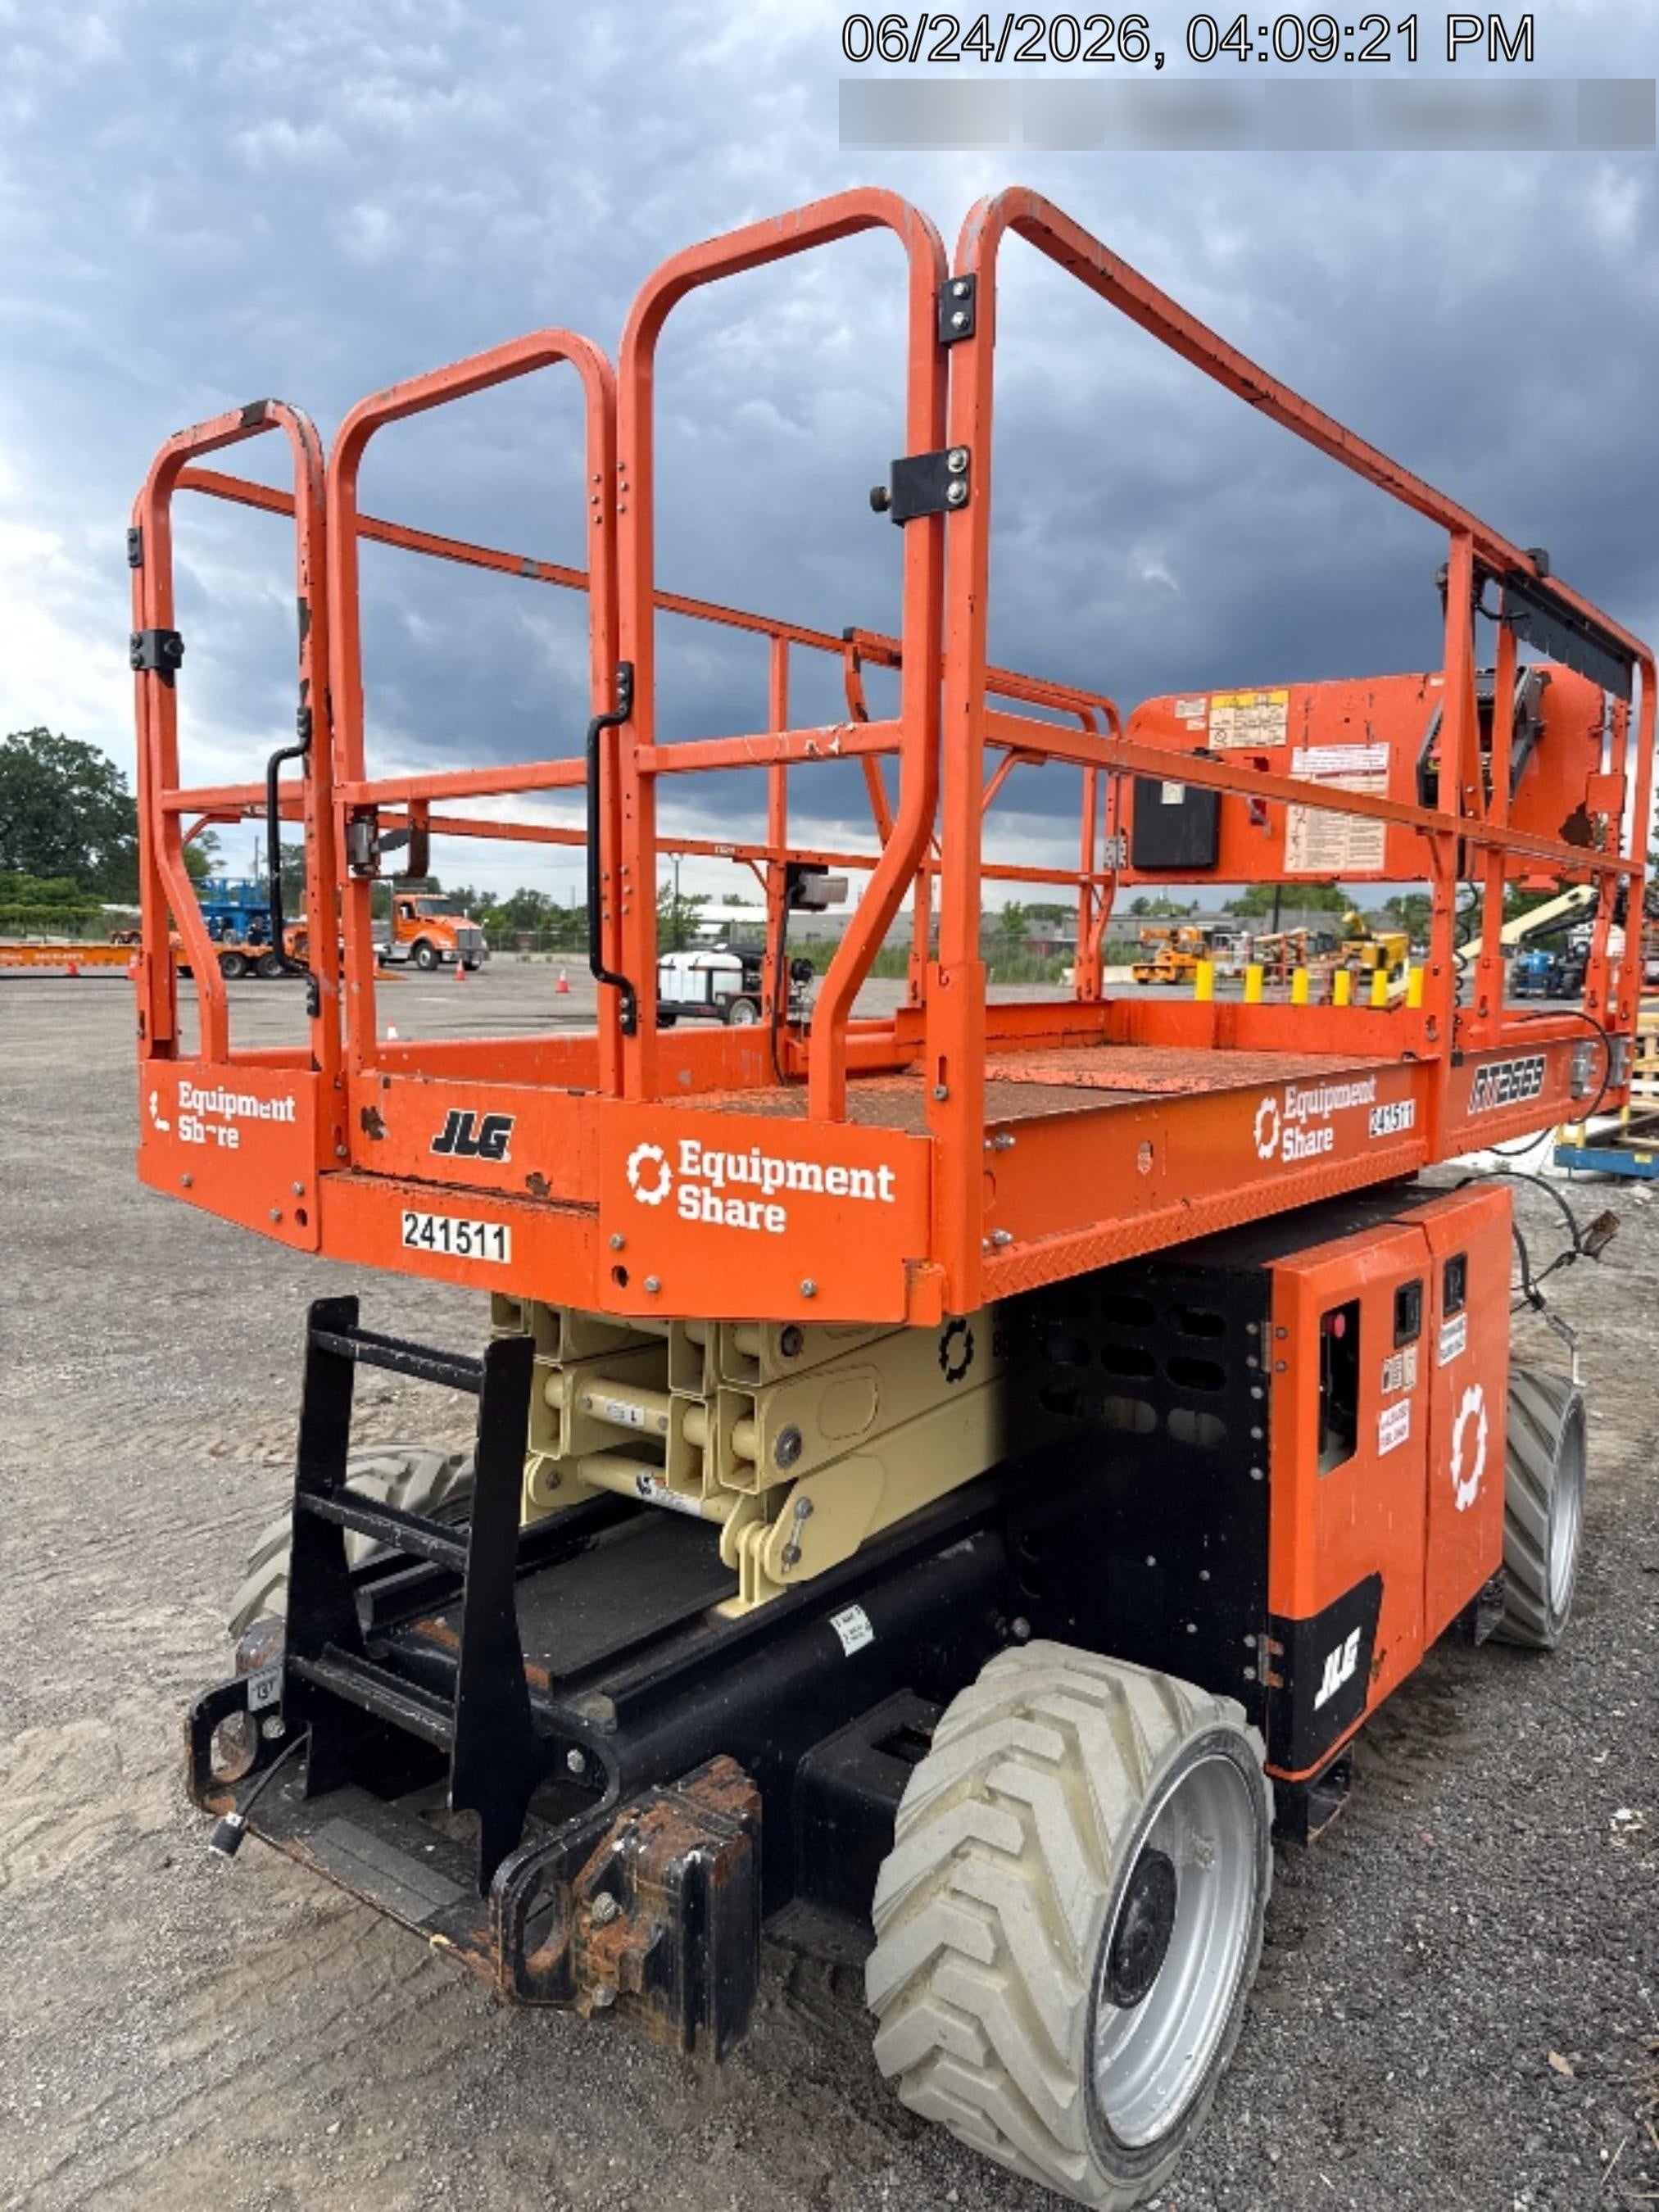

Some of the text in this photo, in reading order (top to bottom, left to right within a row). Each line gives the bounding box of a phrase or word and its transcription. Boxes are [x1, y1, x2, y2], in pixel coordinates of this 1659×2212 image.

[178, 1081, 296, 1122] Equipment
[1285, 1076, 1376, 1124] Equipment
[1371, 1101, 1413, 1135] 241511
[431, 1109, 514, 1163] JLG
[1282, 1126, 1334, 1163] Share
[678, 1140, 895, 1202] Equipment
[678, 1185, 786, 1233] Share
[404, 1214, 506, 1260] 241511
[1314, 1626, 1362, 1711] JLG
